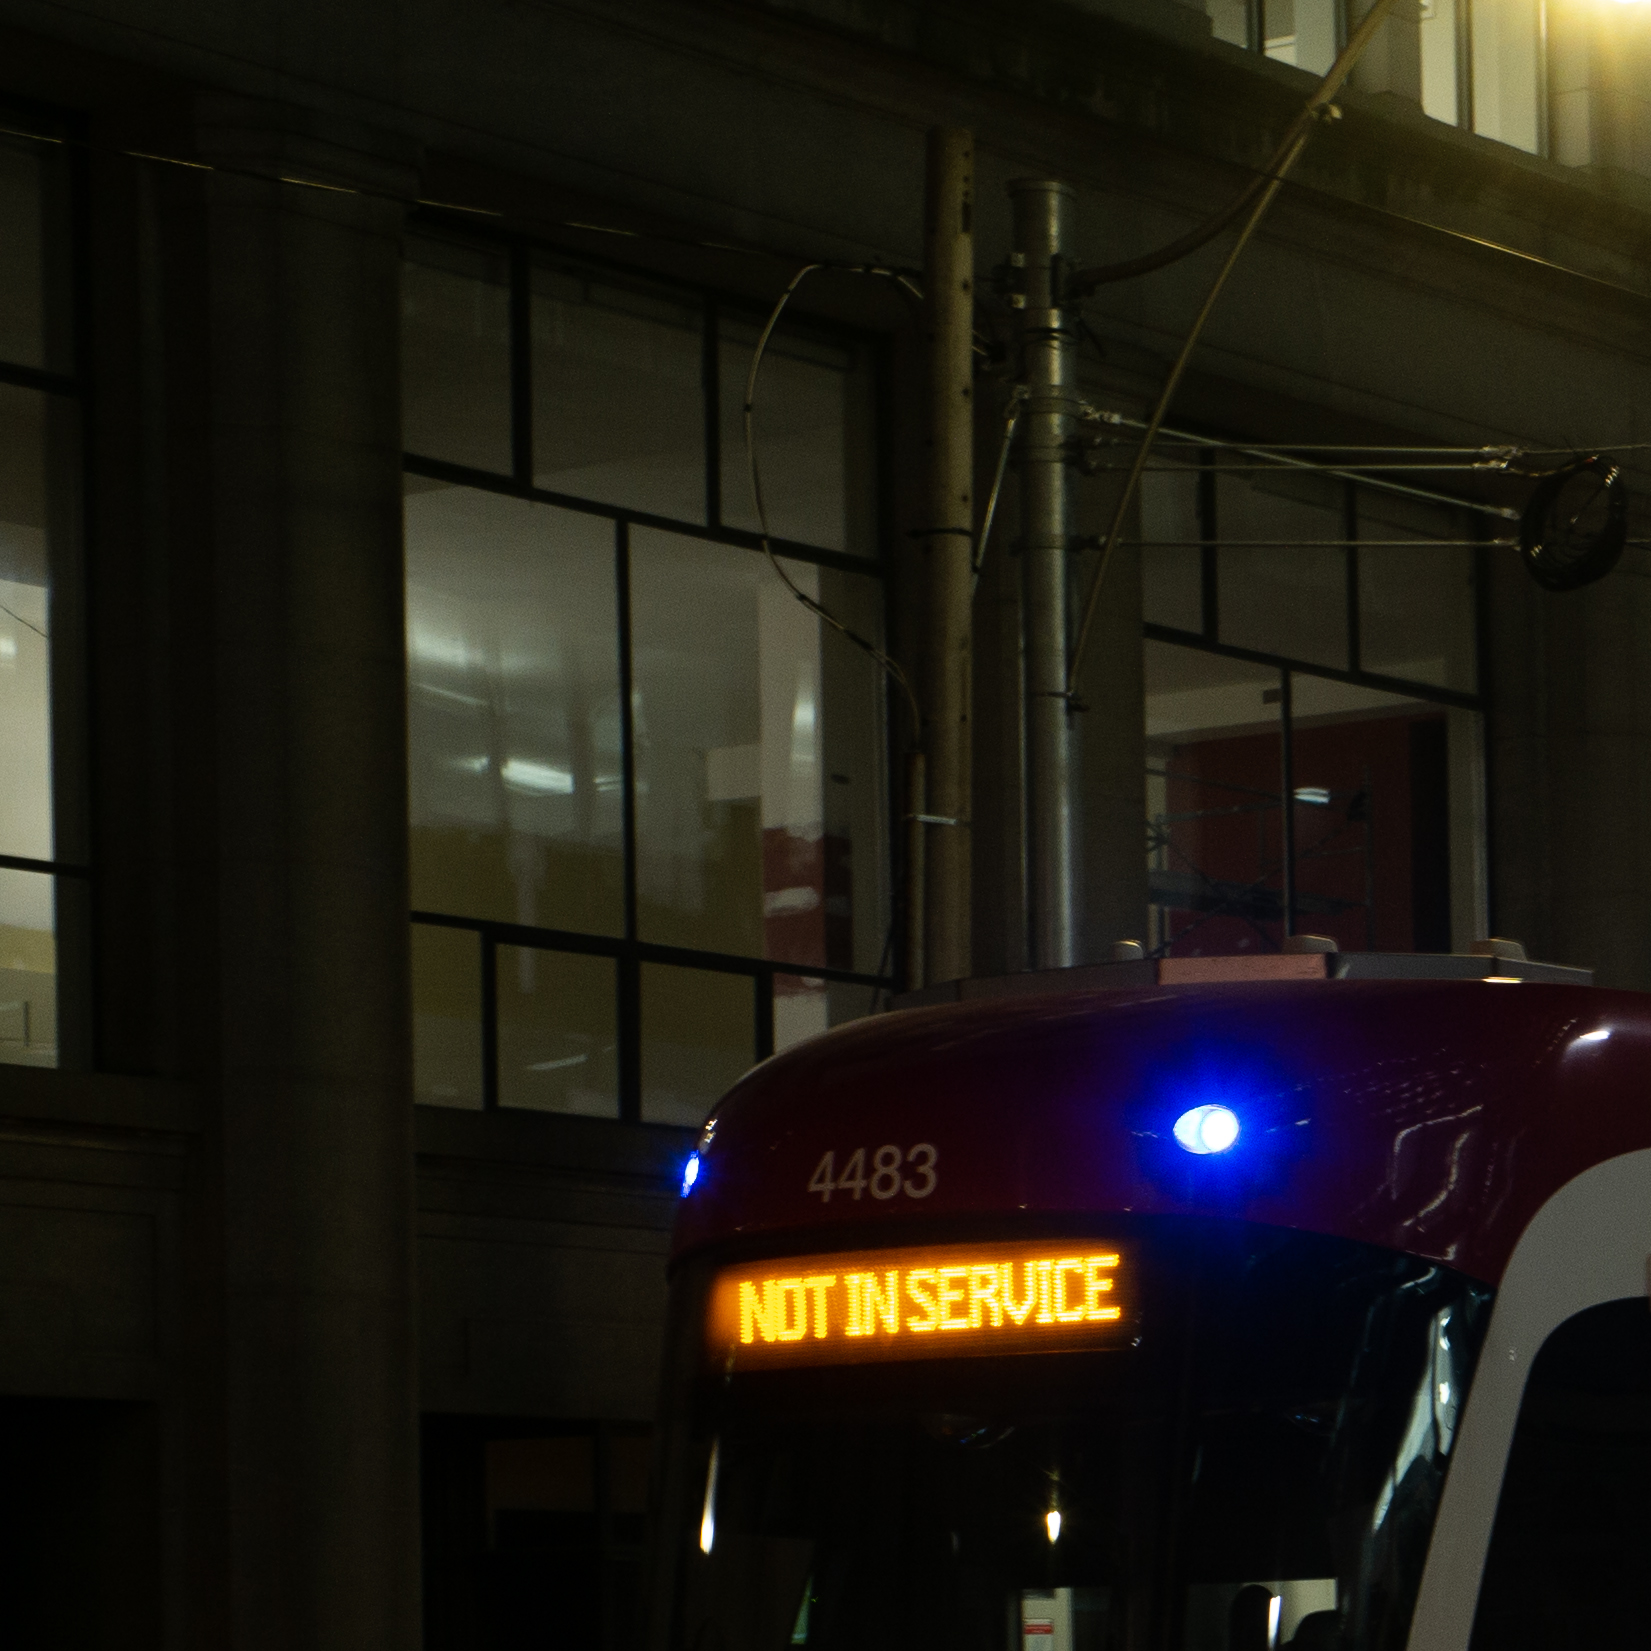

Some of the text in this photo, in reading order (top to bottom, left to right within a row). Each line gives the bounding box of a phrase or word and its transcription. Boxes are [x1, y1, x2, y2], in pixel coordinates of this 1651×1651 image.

[806, 1142, 938, 1203] 4483
[739, 1254, 1121, 1344] NOT IN SERVICE
